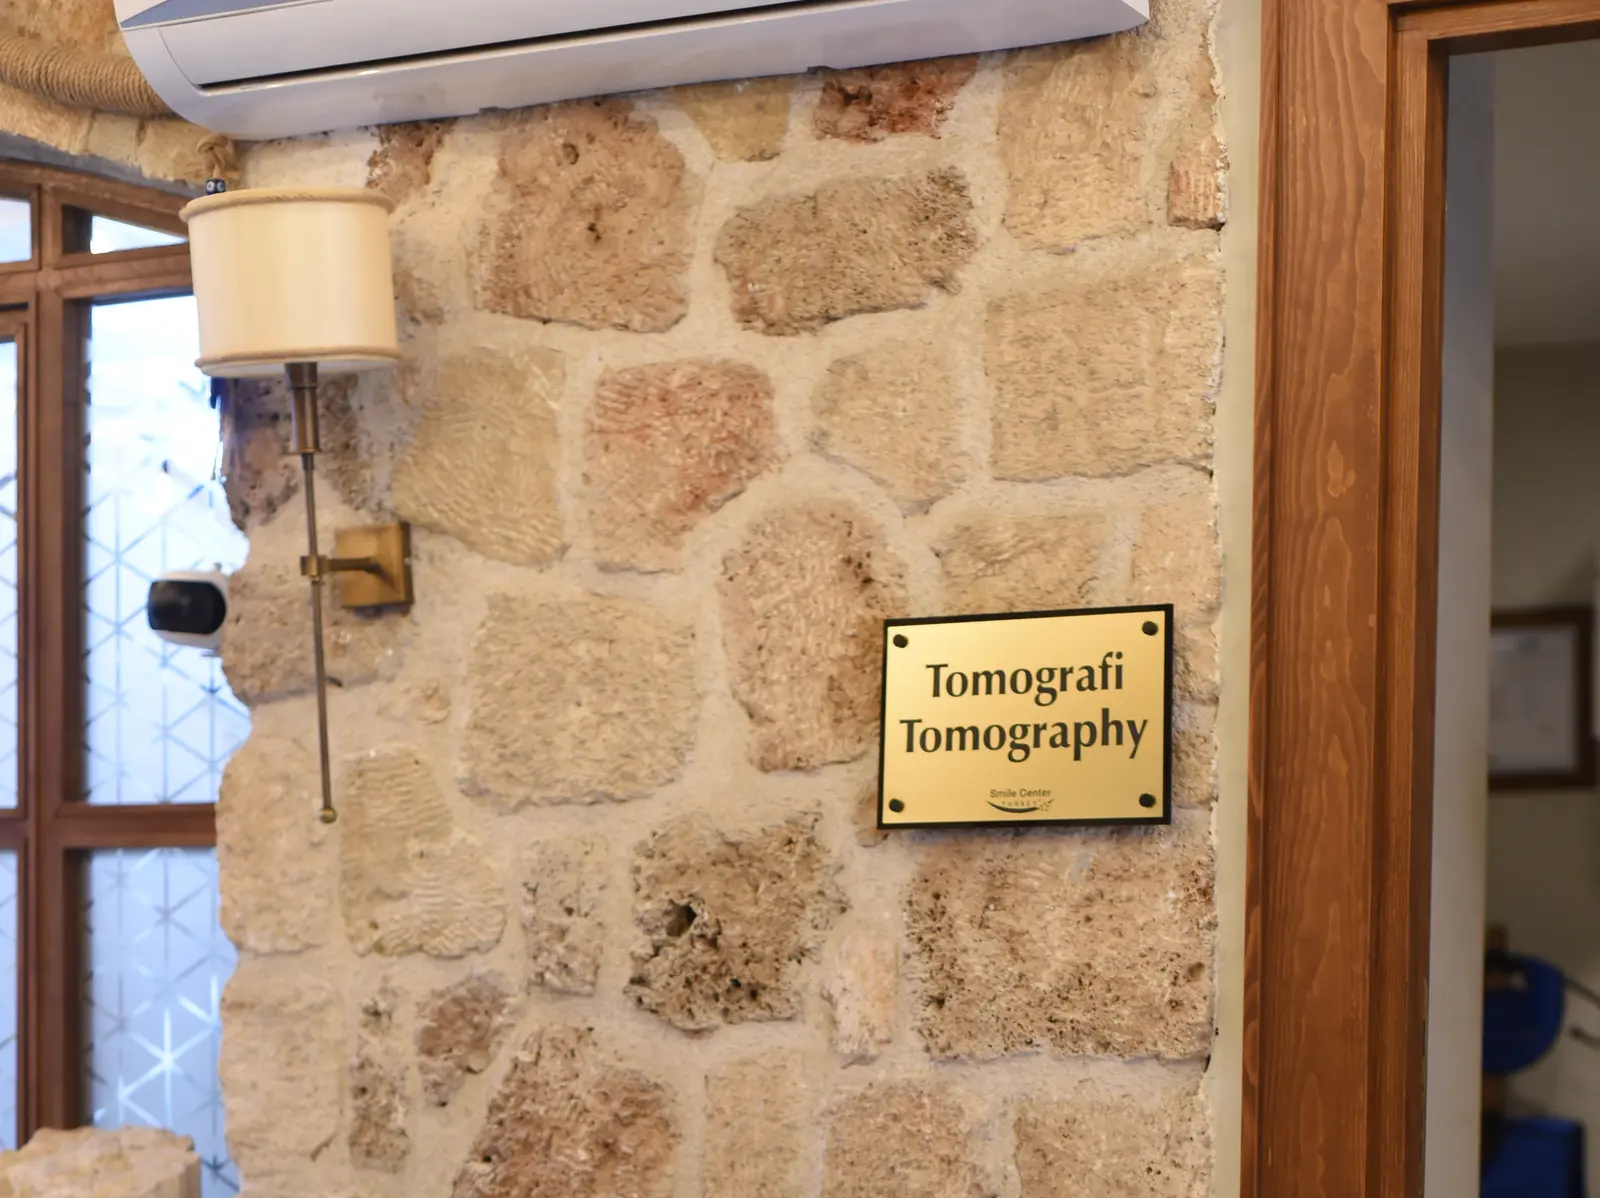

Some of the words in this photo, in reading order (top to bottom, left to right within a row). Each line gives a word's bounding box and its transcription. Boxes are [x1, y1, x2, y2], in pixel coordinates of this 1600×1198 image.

[925, 651, 1124, 707] Tomografi
[899, 707, 1148, 763] Tomography
[989, 789, 1017, 798] Smile
[1019, 788, 1052, 797] Center
